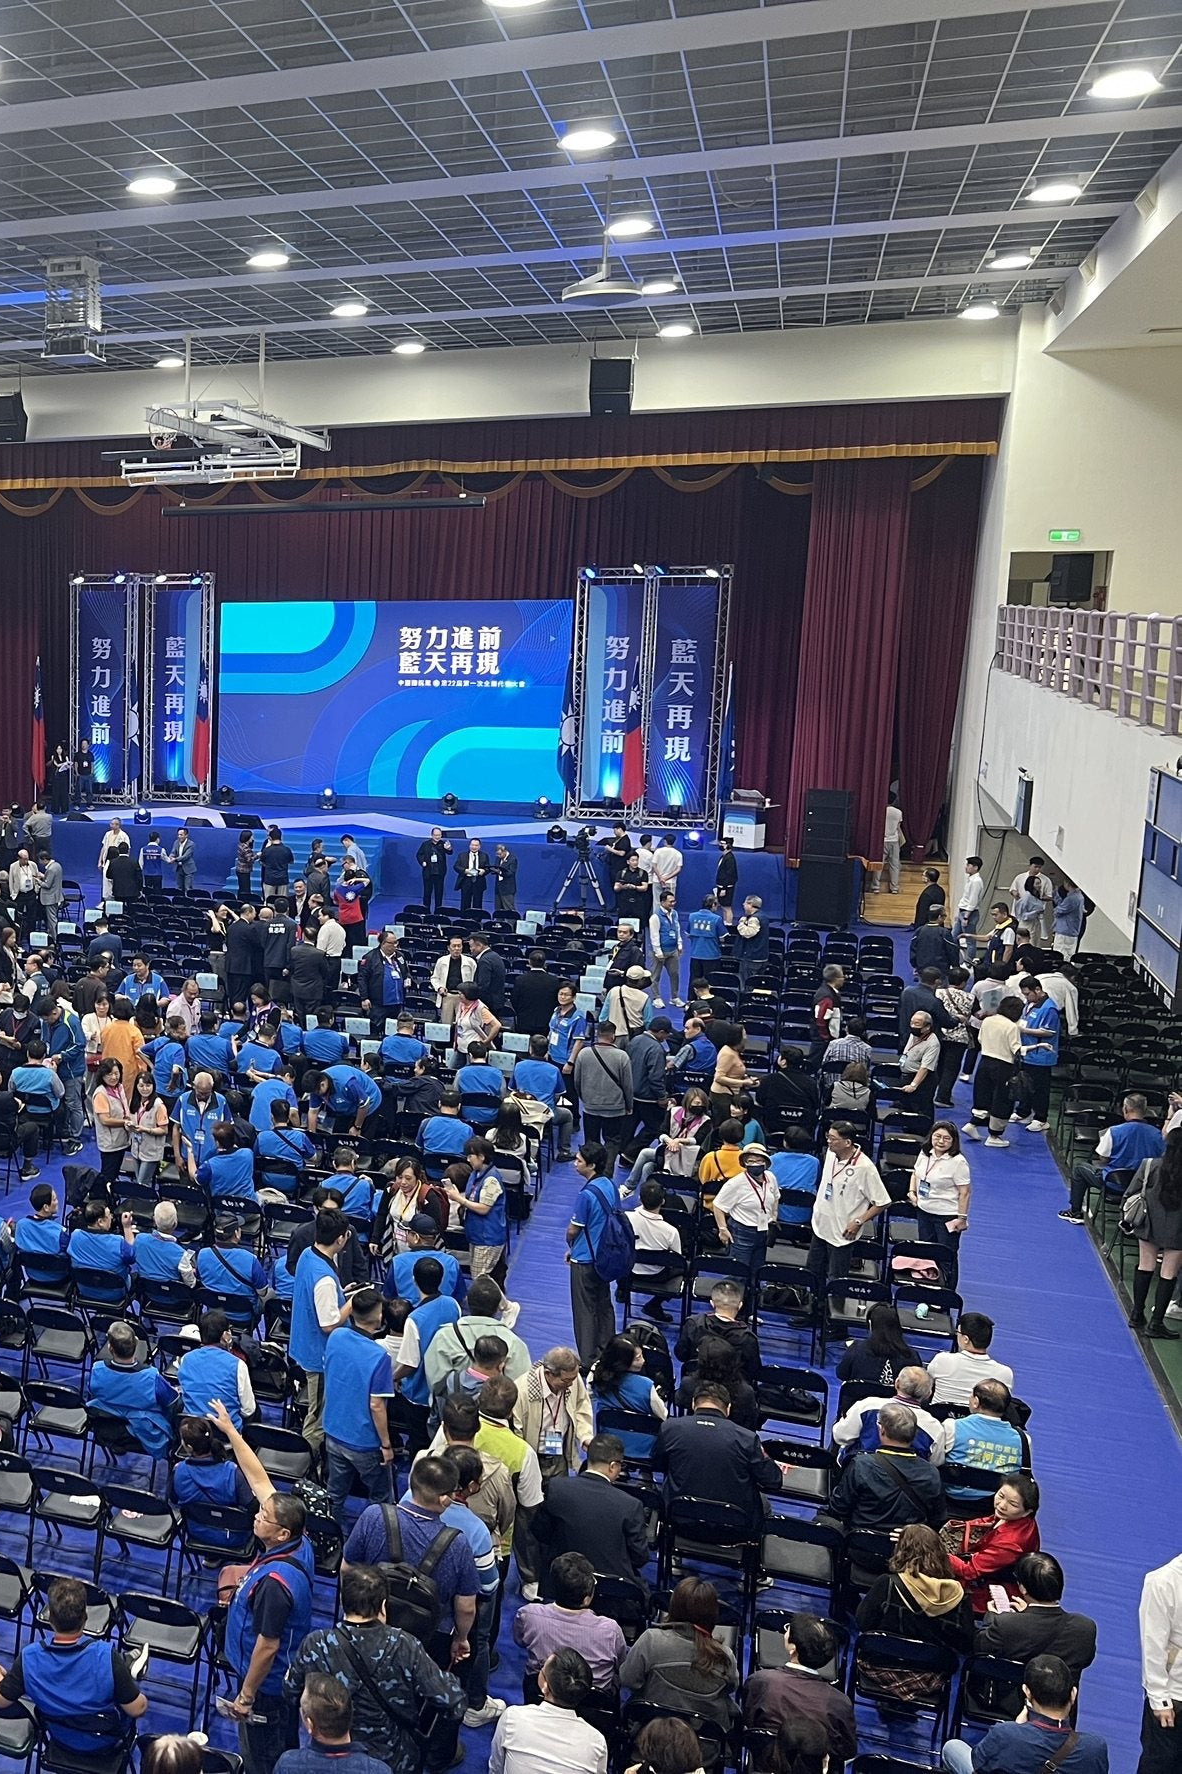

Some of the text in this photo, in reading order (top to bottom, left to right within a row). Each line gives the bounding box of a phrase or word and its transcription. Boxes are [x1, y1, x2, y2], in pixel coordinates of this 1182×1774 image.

[91, 637, 112, 745] 努力進前
[163, 636, 186, 743] 藍天再現
[398, 651, 500, 675] 藍天再現
[399, 626, 502, 650] 努力進前
[601, 636, 630, 754] 努力進前
[664, 639, 698, 762] 藍天再現
